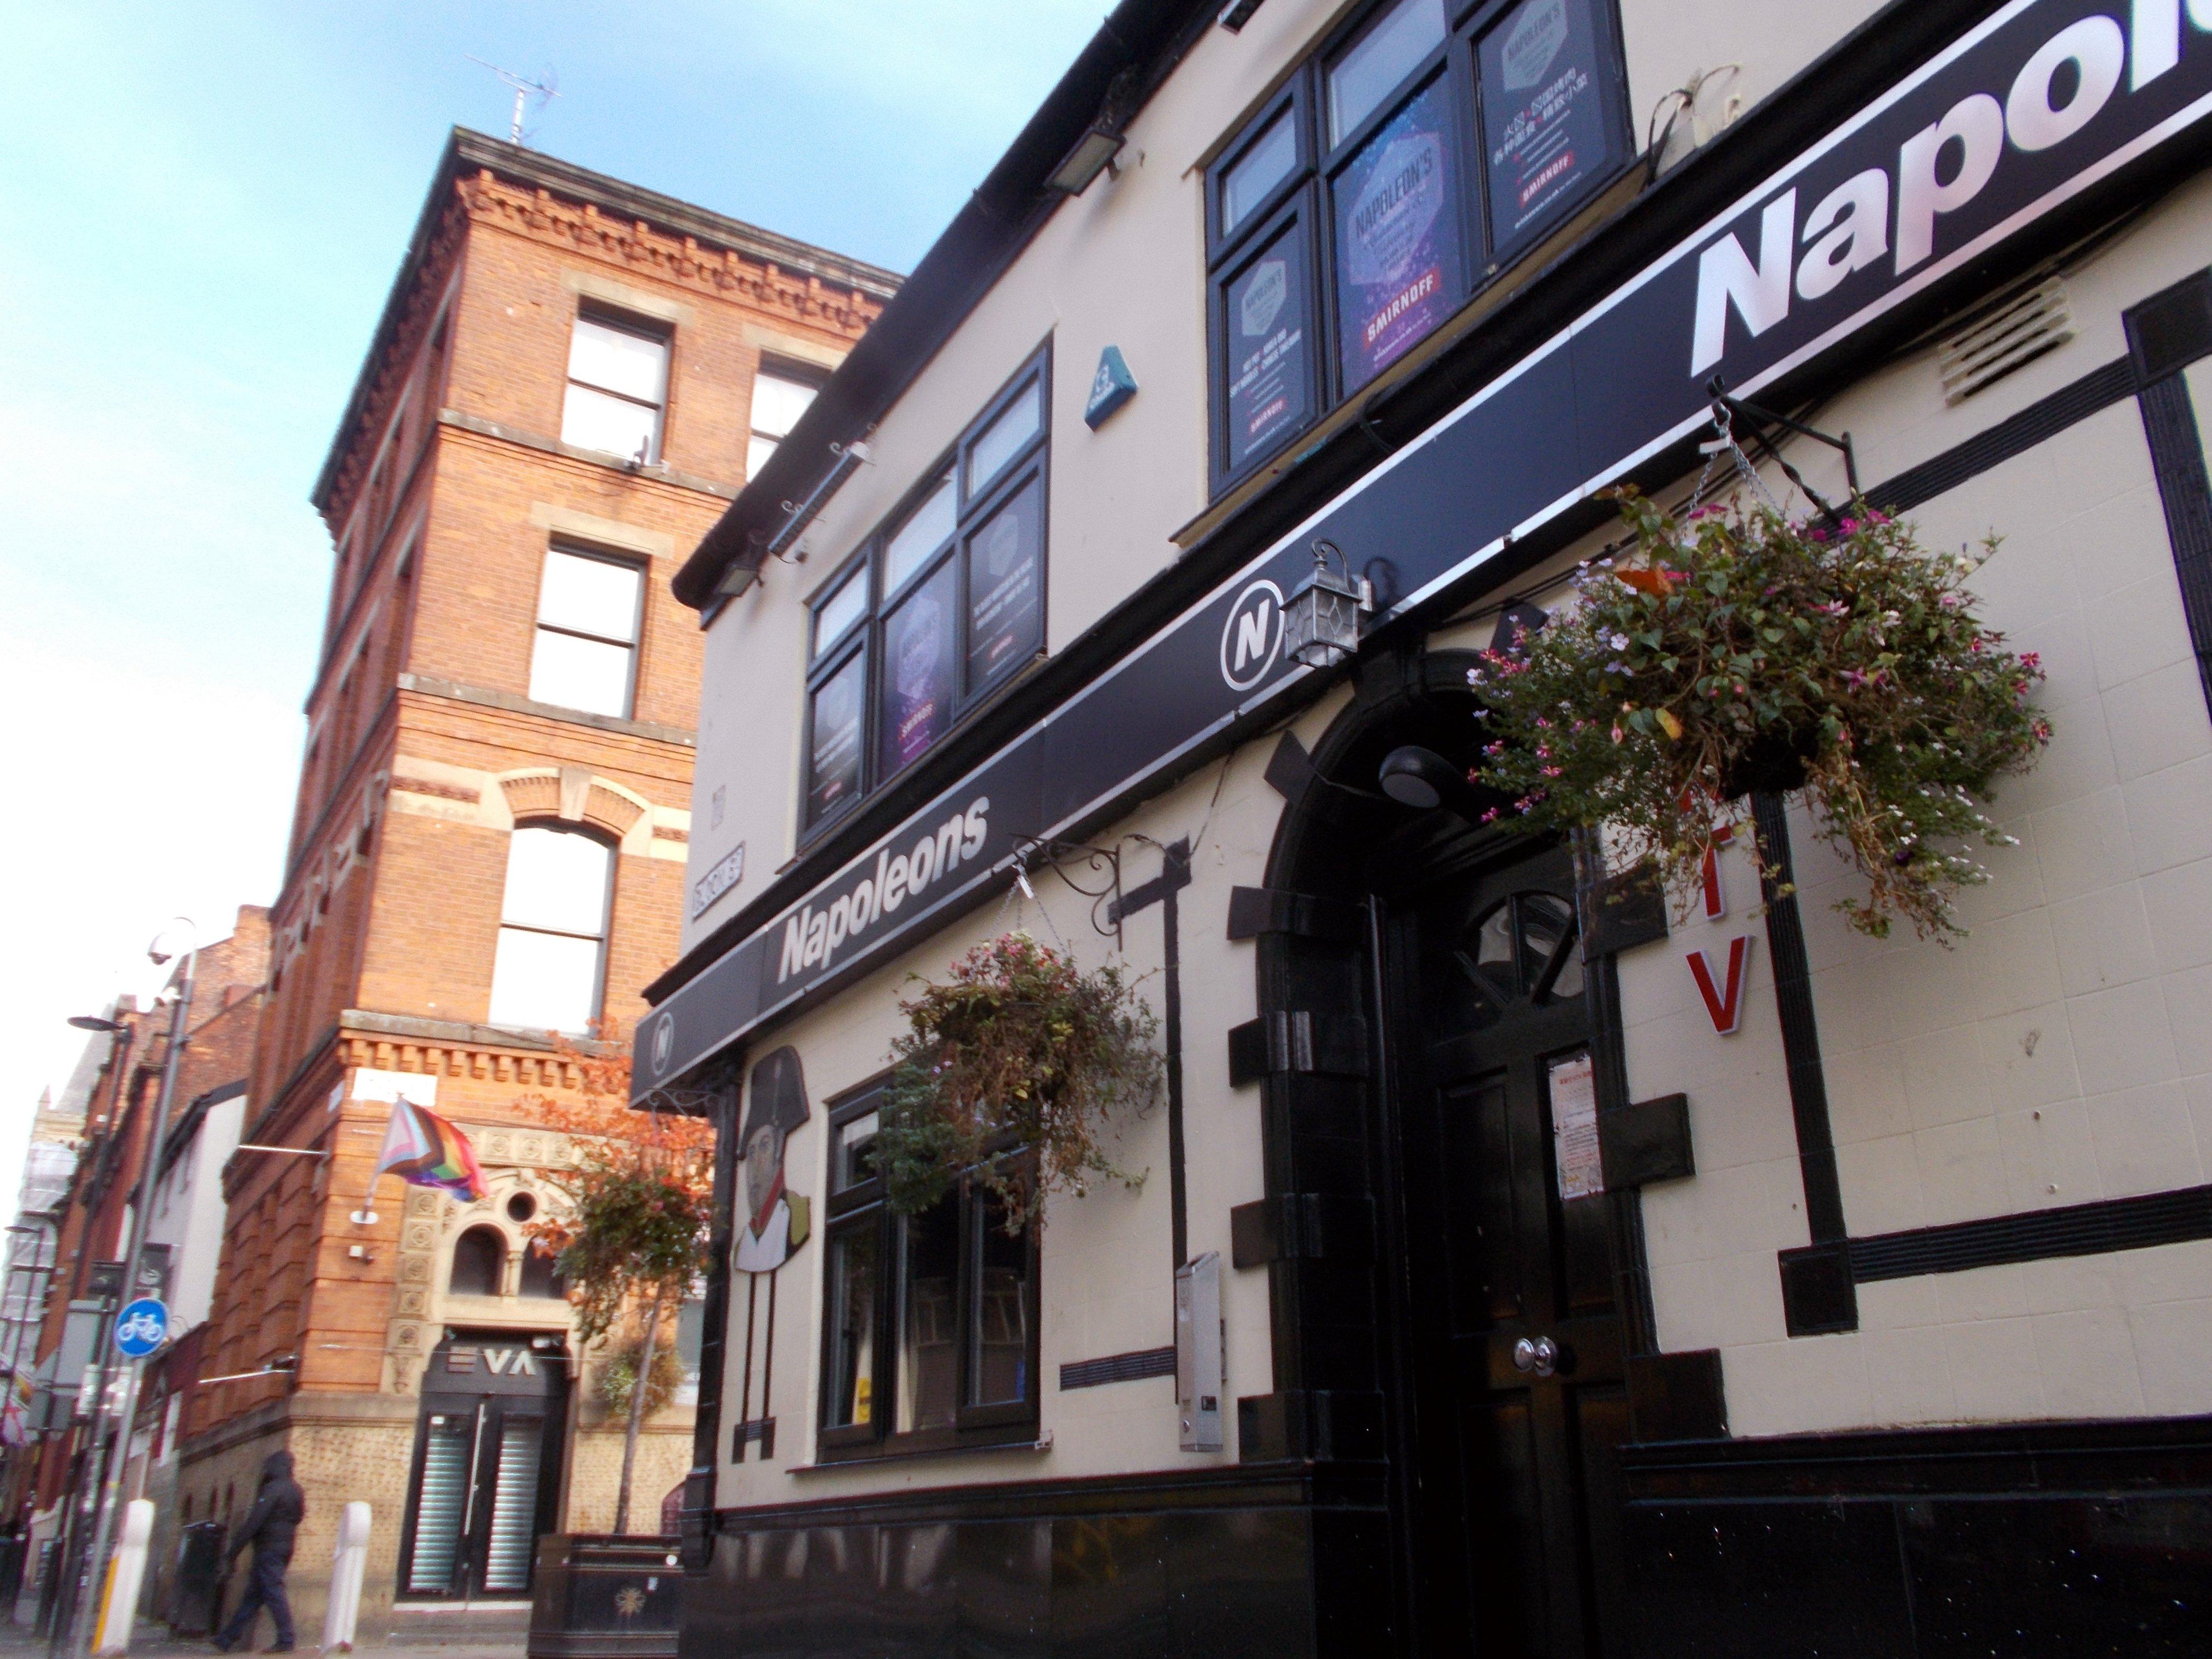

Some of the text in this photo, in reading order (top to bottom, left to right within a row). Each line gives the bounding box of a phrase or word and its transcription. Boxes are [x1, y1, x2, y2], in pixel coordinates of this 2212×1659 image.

[1690, 0, 2212, 378] Napol
[1367, 273, 1433, 343] SMIRNOFF
[1234, 598, 1270, 672] N
[777, 796, 990, 984] Napoleons
[448, 1346, 536, 1376] EVA
